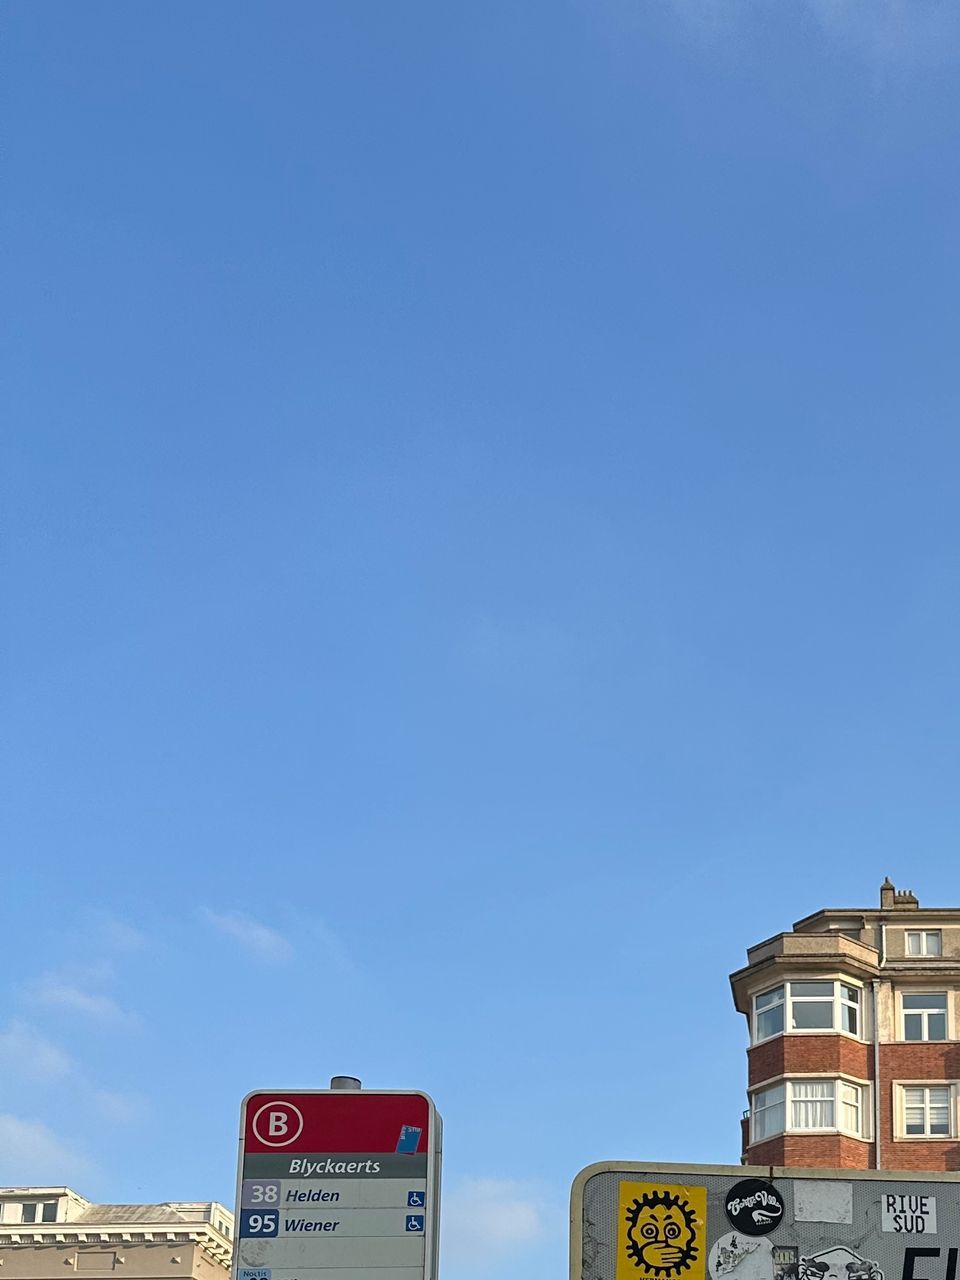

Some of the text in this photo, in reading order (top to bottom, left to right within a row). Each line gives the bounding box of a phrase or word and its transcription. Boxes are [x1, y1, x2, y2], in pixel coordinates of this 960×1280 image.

[269, 1111, 288, 1136] B
[289, 1158, 381, 1177] Blyckaerts
[251, 1185, 340, 1203] 38 Helden
[886, 1195, 930, 1215] RIVE
[249, 1214, 340, 1233] 95 Wiener
[893, 1214, 926, 1234] SUD
